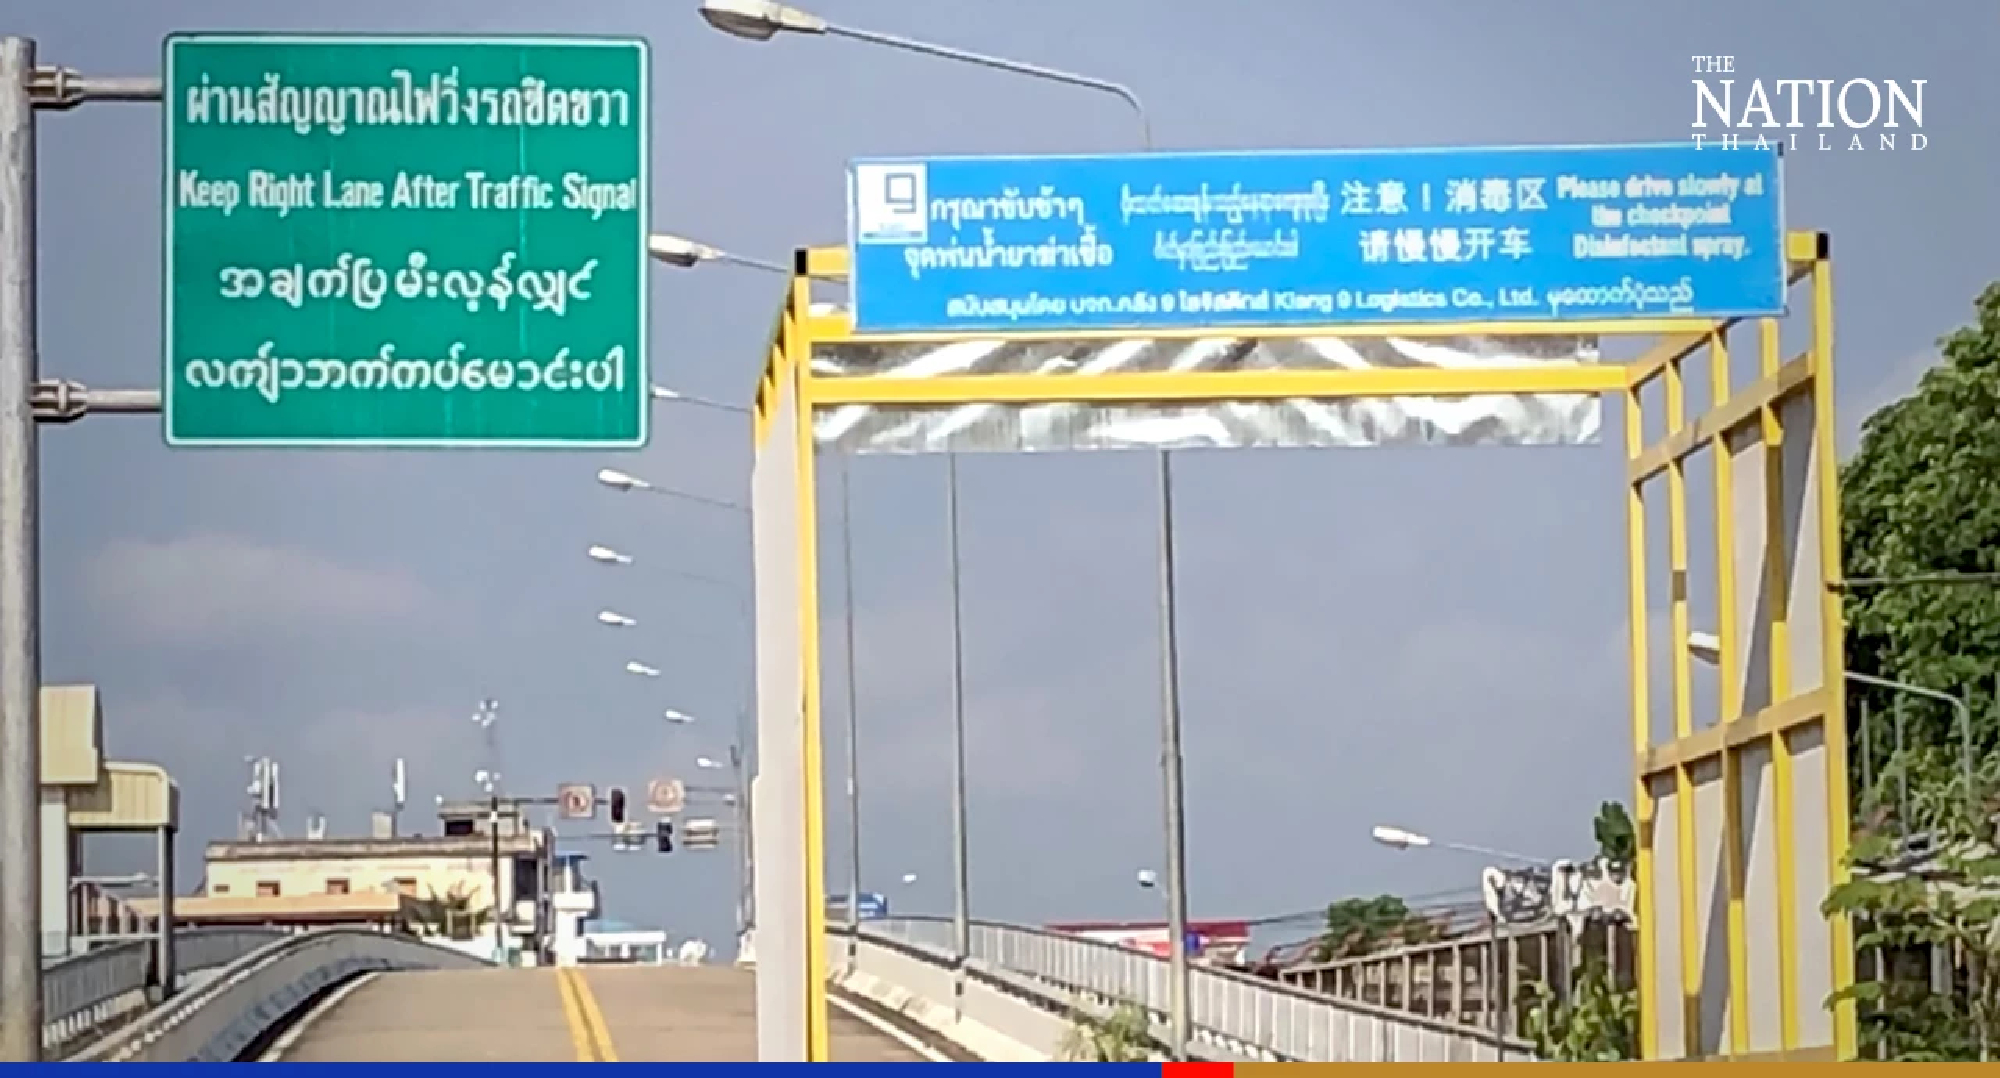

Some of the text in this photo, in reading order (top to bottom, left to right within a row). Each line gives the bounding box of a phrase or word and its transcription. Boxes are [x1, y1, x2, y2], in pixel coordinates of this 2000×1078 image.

[187, 66, 629, 134] ผ่านสัญญาณไฟวิ่งรถชิดขวา
[179, 170, 636, 218] Keep Right Lane After Traffic Signal
[1556, 173, 1621, 199] Please
[1624, 173, 1674, 198] drive
[1677, 172, 1740, 202] slowly
[1591, 202, 1733, 231] the checkpoint
[1358, 227, 1534, 263] 请慢慢开车
[1572, 233, 1688, 259] Disinfectant
[1355, 289, 1448, 314] Logistics
[1499, 287, 1540, 309] Ltd.
